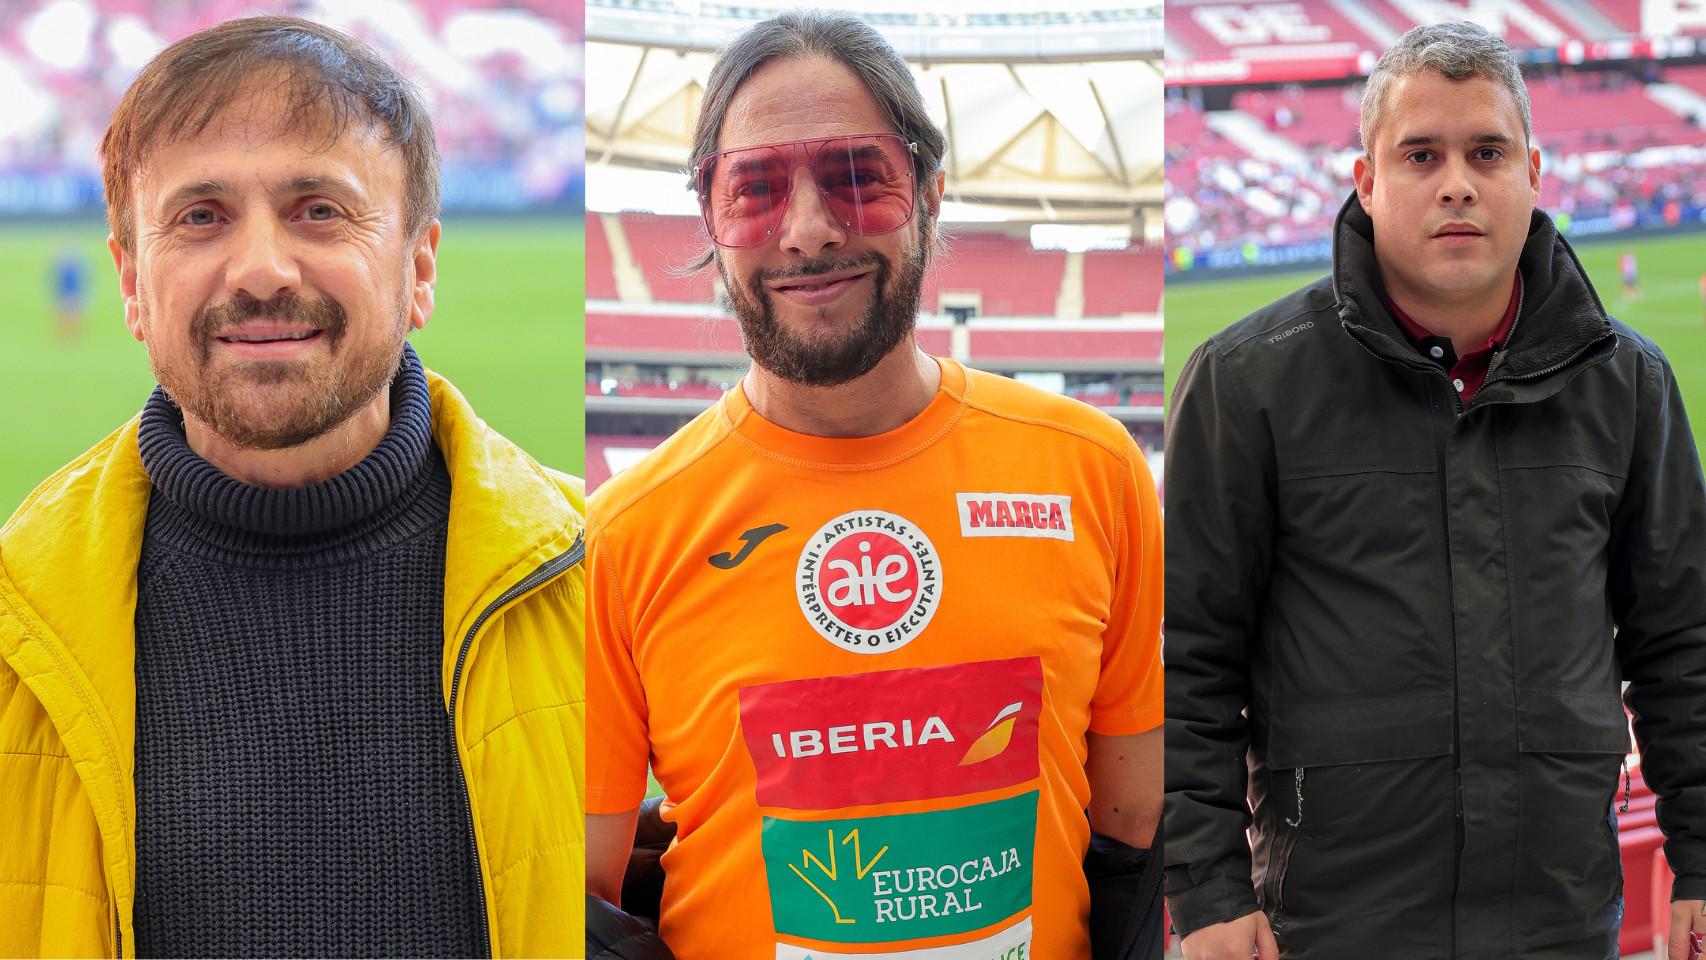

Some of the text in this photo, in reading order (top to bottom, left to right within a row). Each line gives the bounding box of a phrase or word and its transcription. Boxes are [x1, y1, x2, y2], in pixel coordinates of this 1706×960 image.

[1267, 321, 1315, 344] TRIBORD
[823, 516, 907, 544] ARTISTAS
[966, 500, 1067, 531] MARCA
[827, 541, 912, 607] aie
[802, 541, 935, 647] INTÉRPRETES O EJECUTANTES
[772, 716, 956, 759] IBERIA
[872, 847, 1021, 896] EUROCAJA
[874, 889, 982, 924] RURAL
